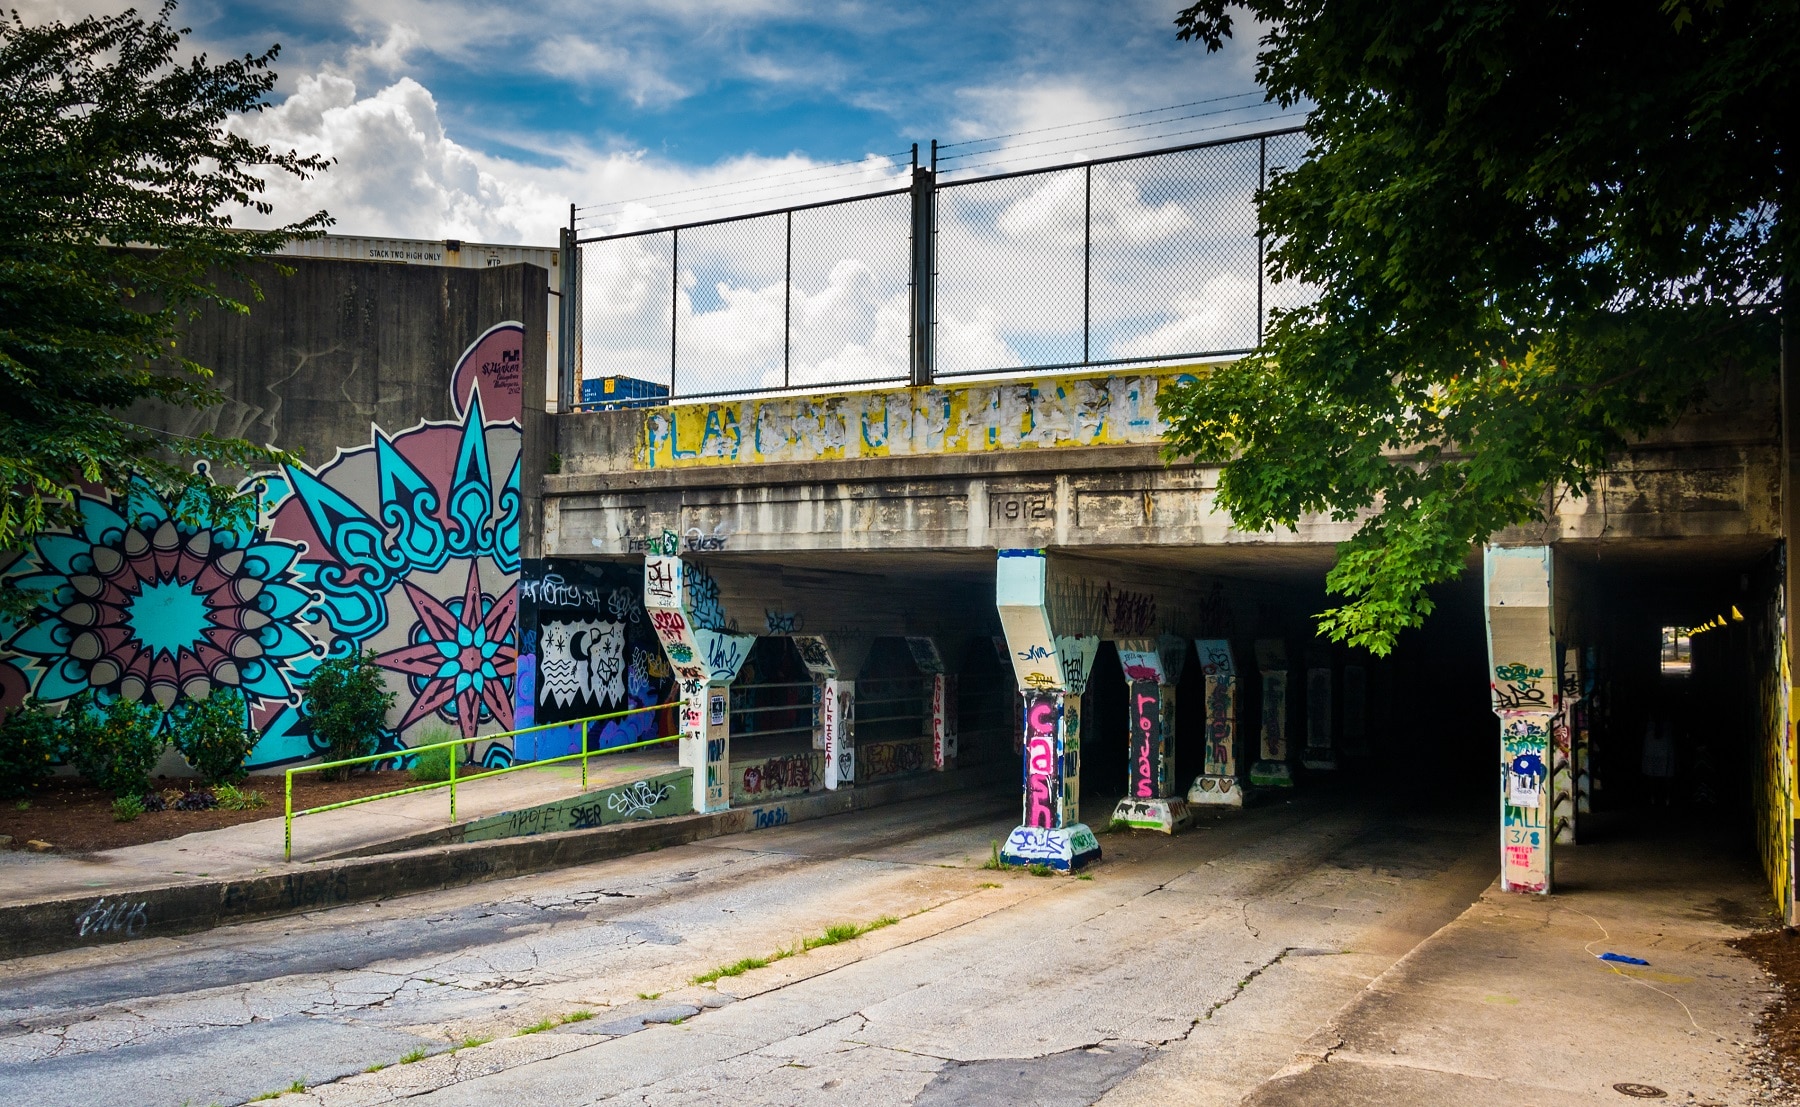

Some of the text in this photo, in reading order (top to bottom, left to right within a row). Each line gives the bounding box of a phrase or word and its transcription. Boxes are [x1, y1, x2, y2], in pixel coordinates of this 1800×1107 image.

[369, 249, 441, 261] STACK TWO HIGH ONLY
[997, 500, 1047, 520] 1912
[1136, 693, 1156, 797] rojas
[1030, 704, 1052, 828] cash
[1510, 829, 1540, 846] 3/8
